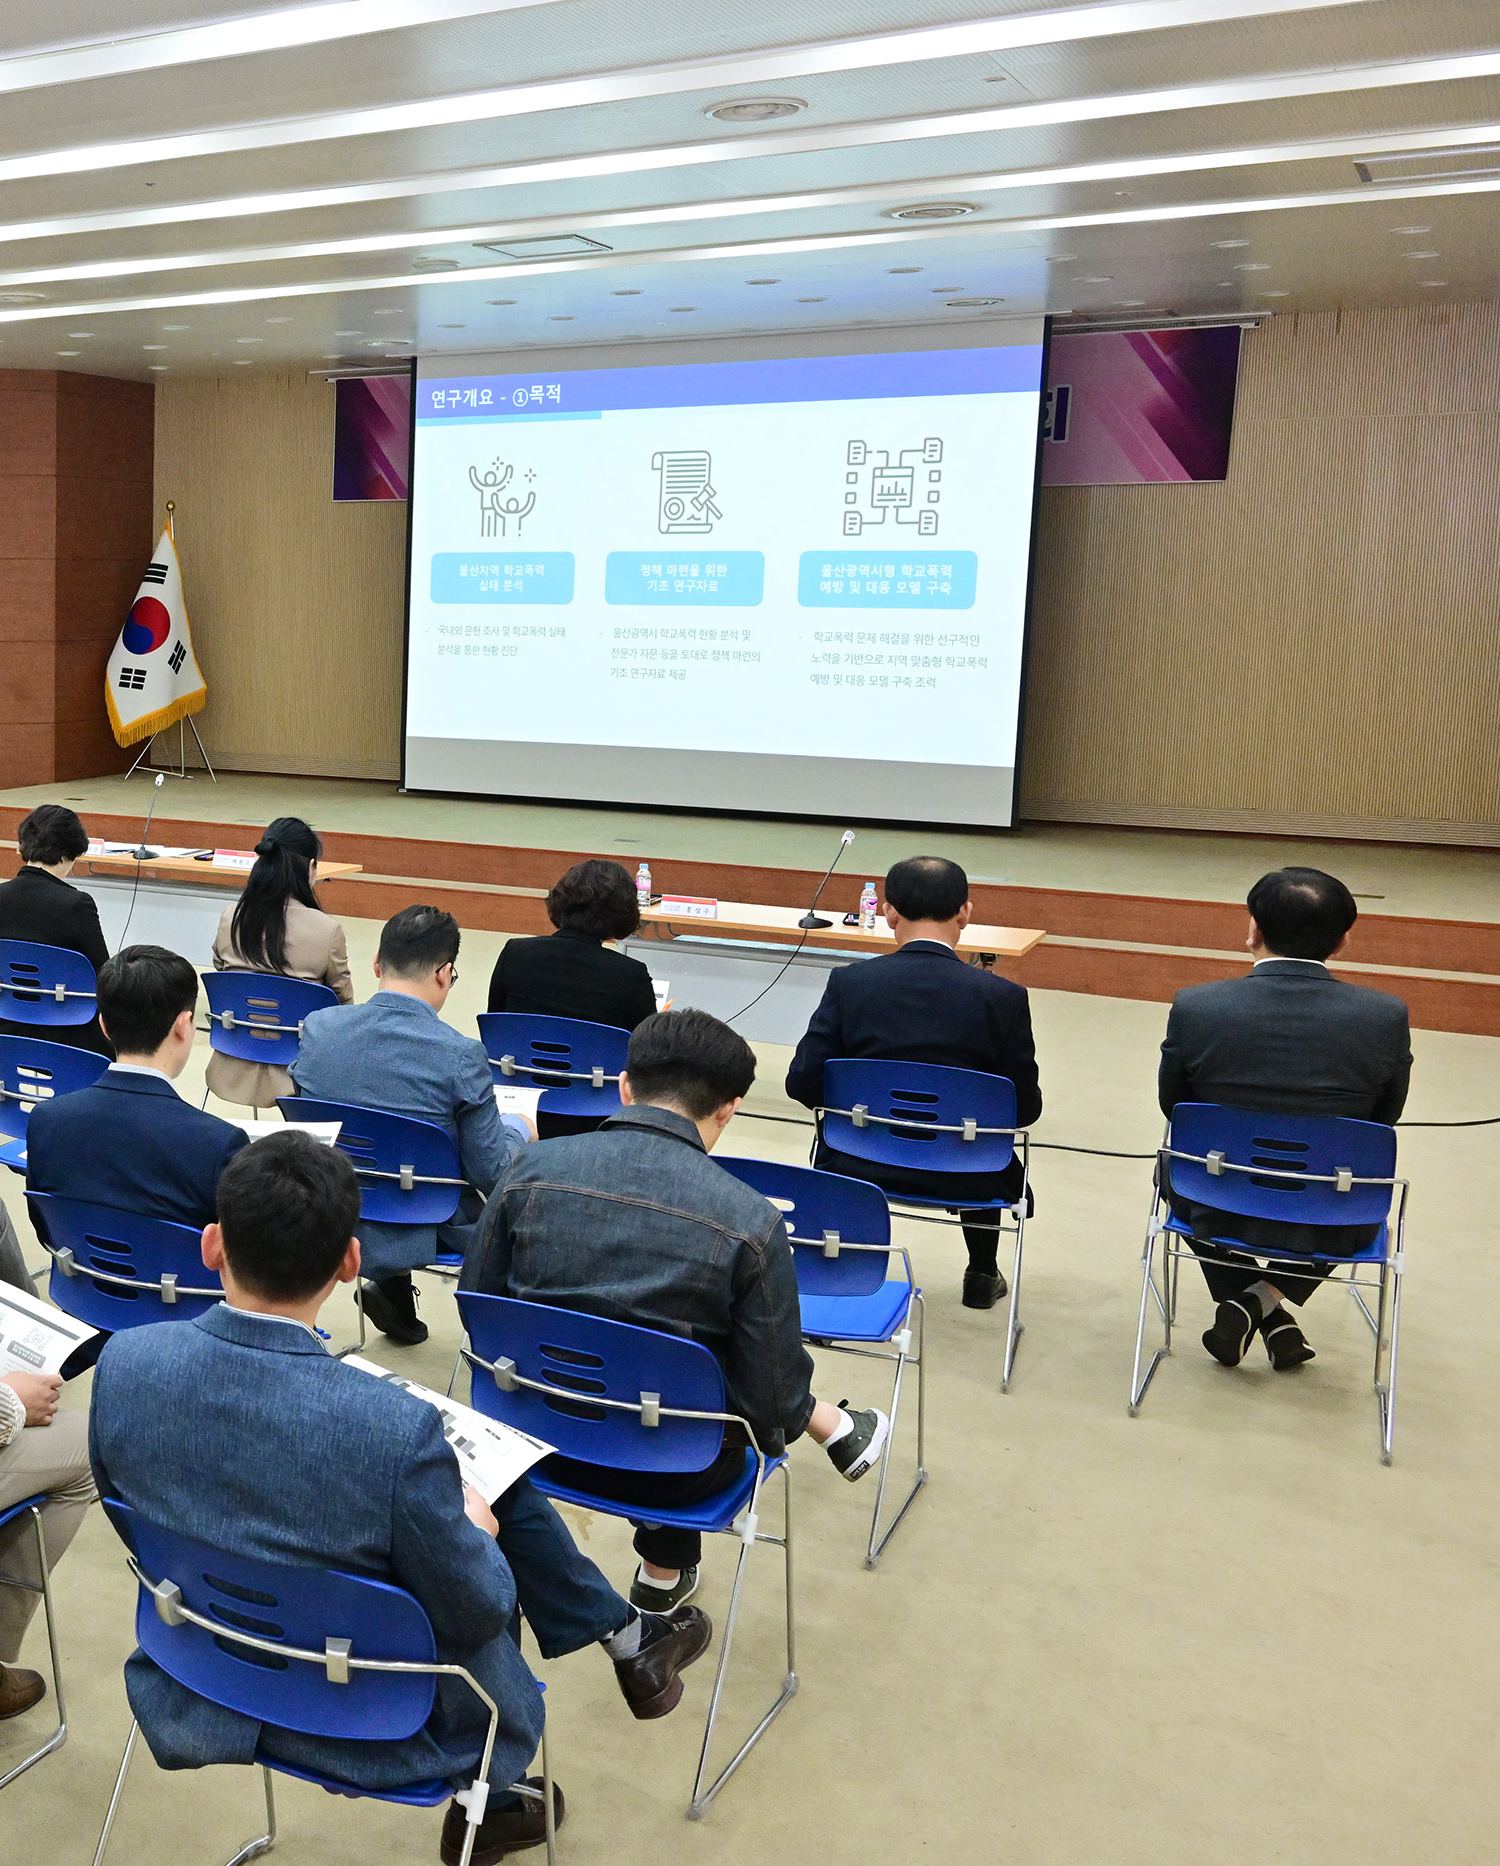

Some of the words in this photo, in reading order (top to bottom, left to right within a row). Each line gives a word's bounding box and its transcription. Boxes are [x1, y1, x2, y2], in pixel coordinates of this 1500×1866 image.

[432, 389, 493, 409] 연구개요
[460, 564, 500, 576] 울산지역
[504, 564, 545, 576] 학교폭력
[640, 564, 662, 577] 정책
[667, 564, 700, 577] 마련을
[705, 564, 727, 577] 위한
[821, 564, 895, 578] 울산광역시형
[901, 564, 953, 578] 학교폭력
[480, 579, 499, 592] 실태
[503, 580, 523, 592] 분석
[647, 580, 669, 592] 기초
[674, 580, 719, 592] 연구자료
[820, 581, 844, 594] 예방
[849, 581, 861, 595] 및
[866, 581, 890, 595] 대응
[895, 581, 921, 595] 모델
[926, 581, 953, 595] 구축
[438, 625, 462, 636] 국내외
[465, 625, 481, 636] 문헌
[483, 626, 499, 636] 조사
[502, 626, 510, 636] 및
[512, 626, 546, 637] 학교폭력
[549, 627, 566, 638] 실태
[613, 628, 657, 639] 울산광역시
[660, 628, 696, 640] 학교폭력
[699, 629, 717, 640] 현황
[720, 630, 738, 641] 분석
[742, 630, 751, 642] 및
[813, 631, 853, 643] 학교폭력
[856, 632, 877, 644] 문제
[879, 633, 910, 645] 해결을
[913, 633, 934, 646] 위한
[937, 634, 980, 647] 선구적인
[437, 644, 461, 656] 분석을
[464, 645, 480, 656] 통한
[501, 645, 518, 656] 진단
[611, 648, 637, 659] 전문가
[640, 648, 658, 660] 자문
[660, 649, 678, 660] 등을
[681, 649, 708, 661] 토대로
[711, 650, 730, 661] 정책
[733, 650, 761, 662] 마련의
[811, 652, 841, 665] 노력을
[844, 653, 884, 666] 기반으로
[887, 654, 908, 667] 지역
[911, 655, 942, 668] 맞춤형
[946, 656, 988, 669] 학교폭력
[610, 667, 628, 678] 기초
[631, 668, 666, 679] 연구자료
[668, 669, 687, 680] 제공
[810, 673, 830, 686] 예방
[833, 674, 844, 686] 및
[845, 675, 866, 687] 대응
[868, 675, 889, 688] 모델
[892, 676, 913, 688] 구축
